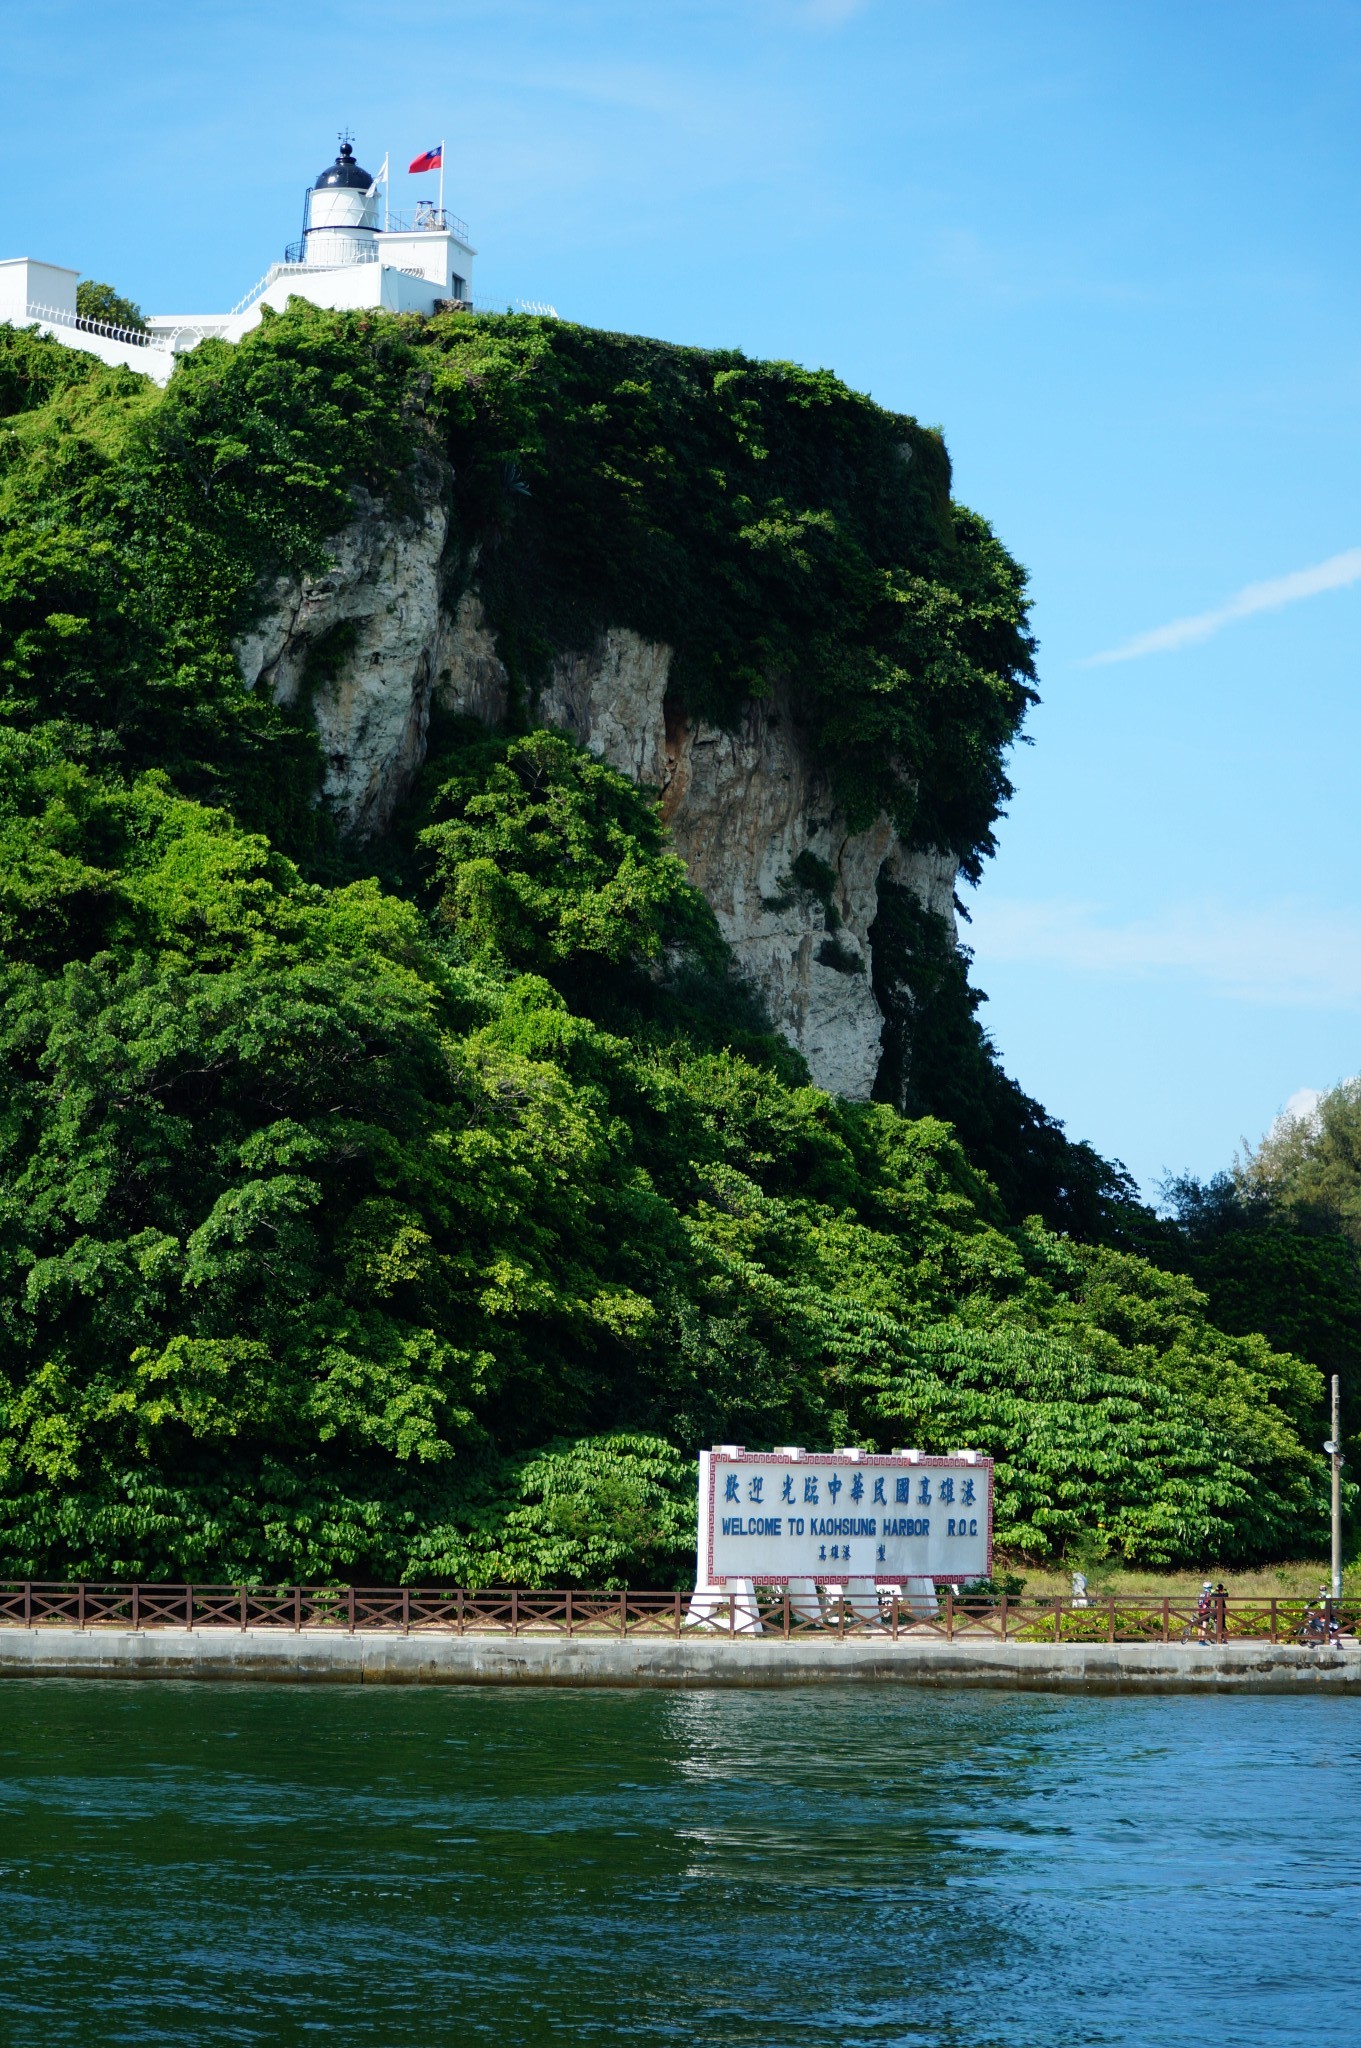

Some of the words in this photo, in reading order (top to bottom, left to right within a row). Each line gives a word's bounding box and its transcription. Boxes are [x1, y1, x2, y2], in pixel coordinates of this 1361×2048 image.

[722, 1517, 782, 1536] WELCOME
[788, 1517, 804, 1536] TO
[811, 1517, 876, 1537] KAOHSIUNG
[882, 1518, 930, 1537] HARBOR
